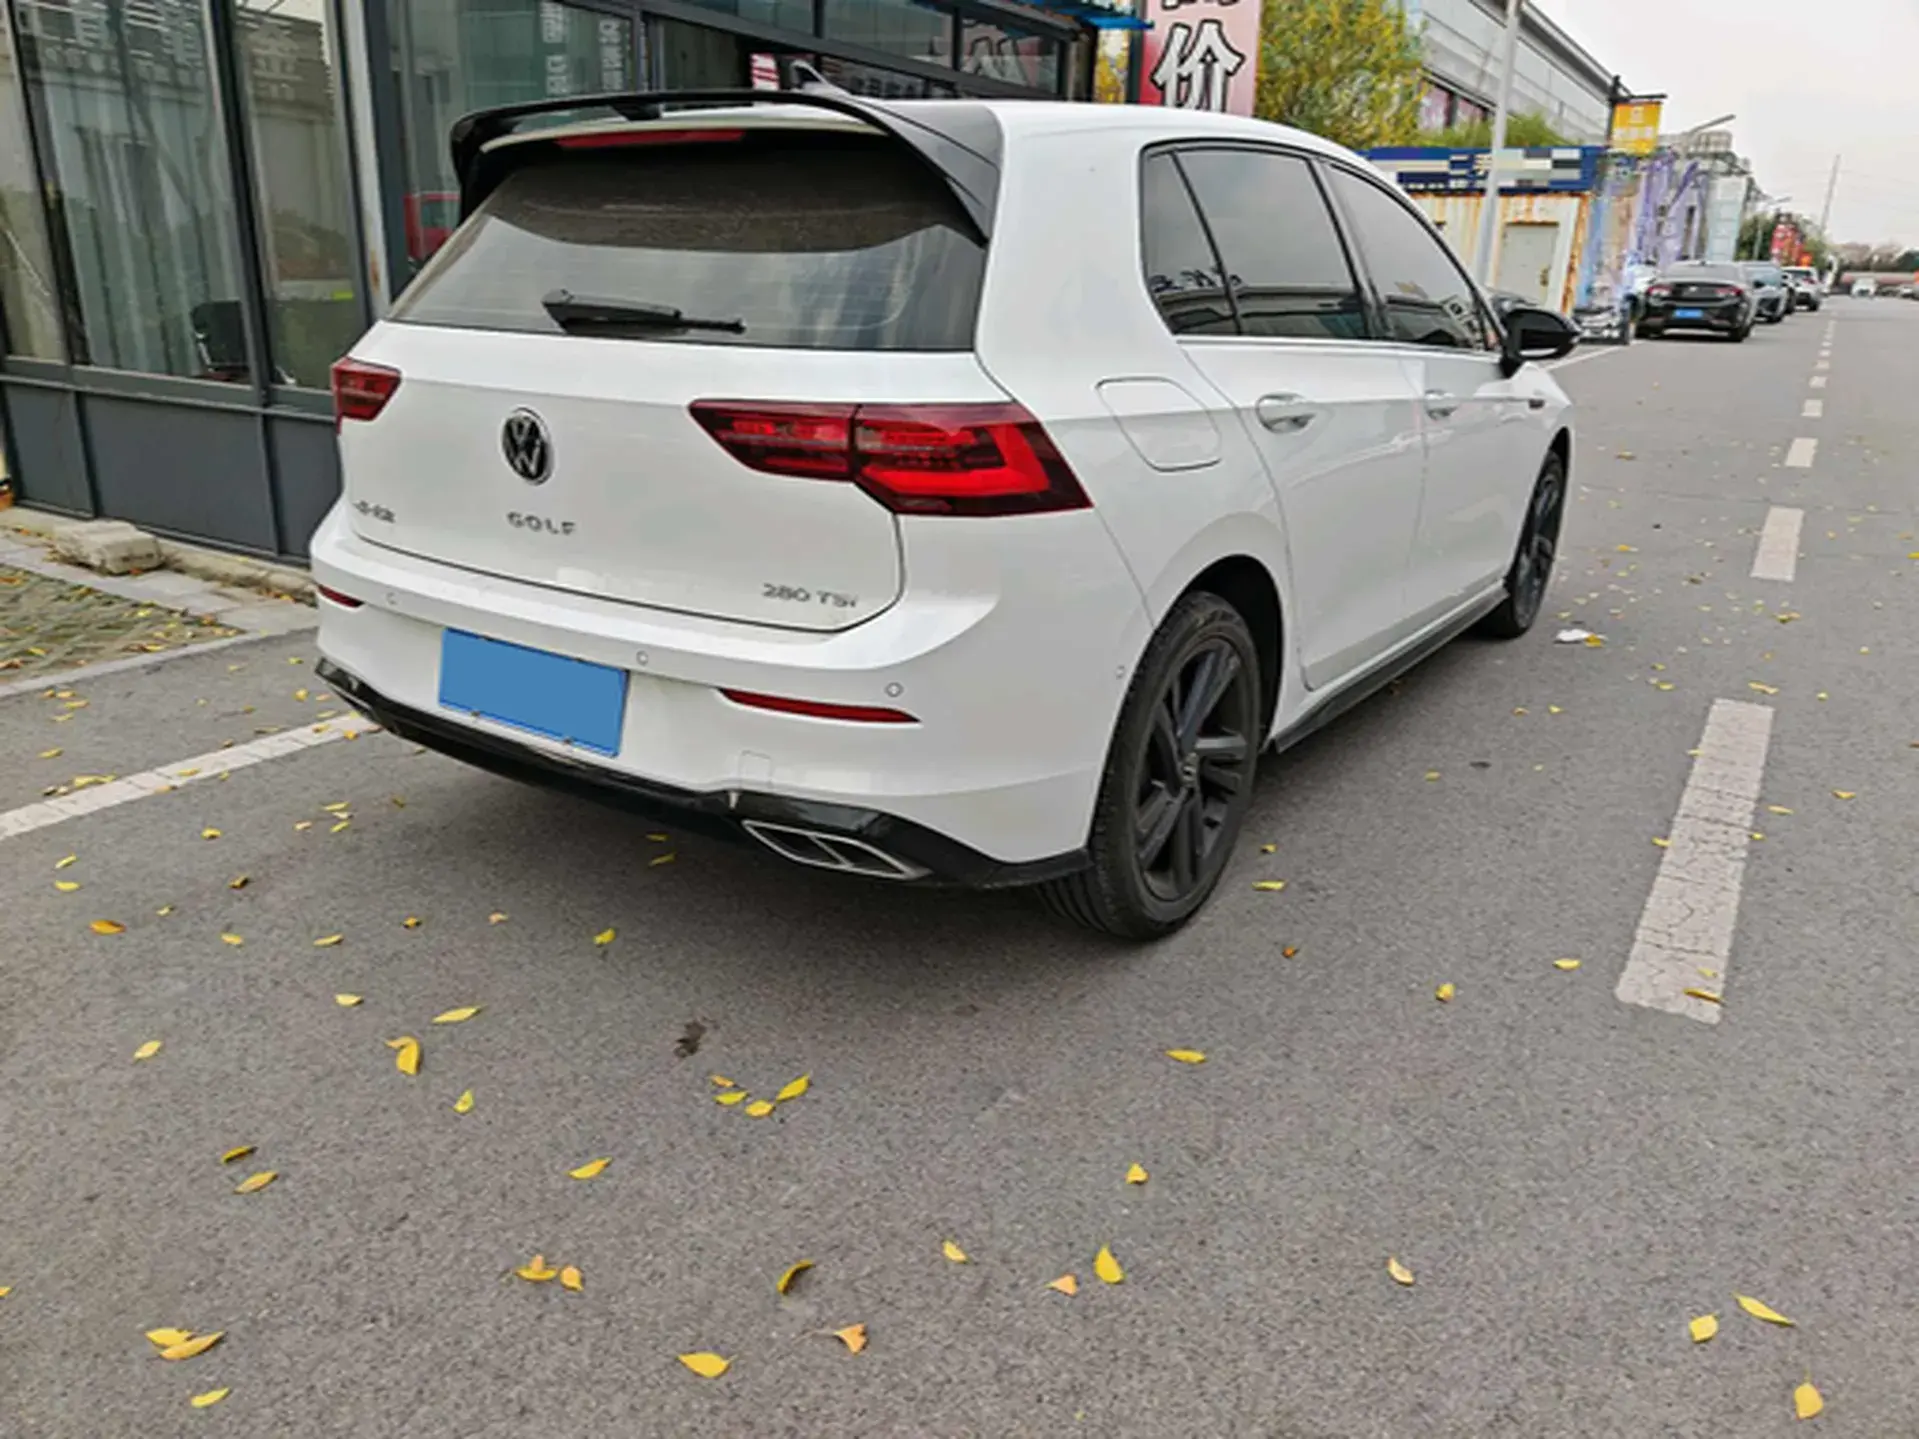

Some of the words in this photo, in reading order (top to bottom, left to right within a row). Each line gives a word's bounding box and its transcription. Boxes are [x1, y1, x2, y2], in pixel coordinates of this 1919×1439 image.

[1150, 0, 1246, 112] 价
[506, 511, 576, 535] GOLF
[762, 582, 811, 602] 280
